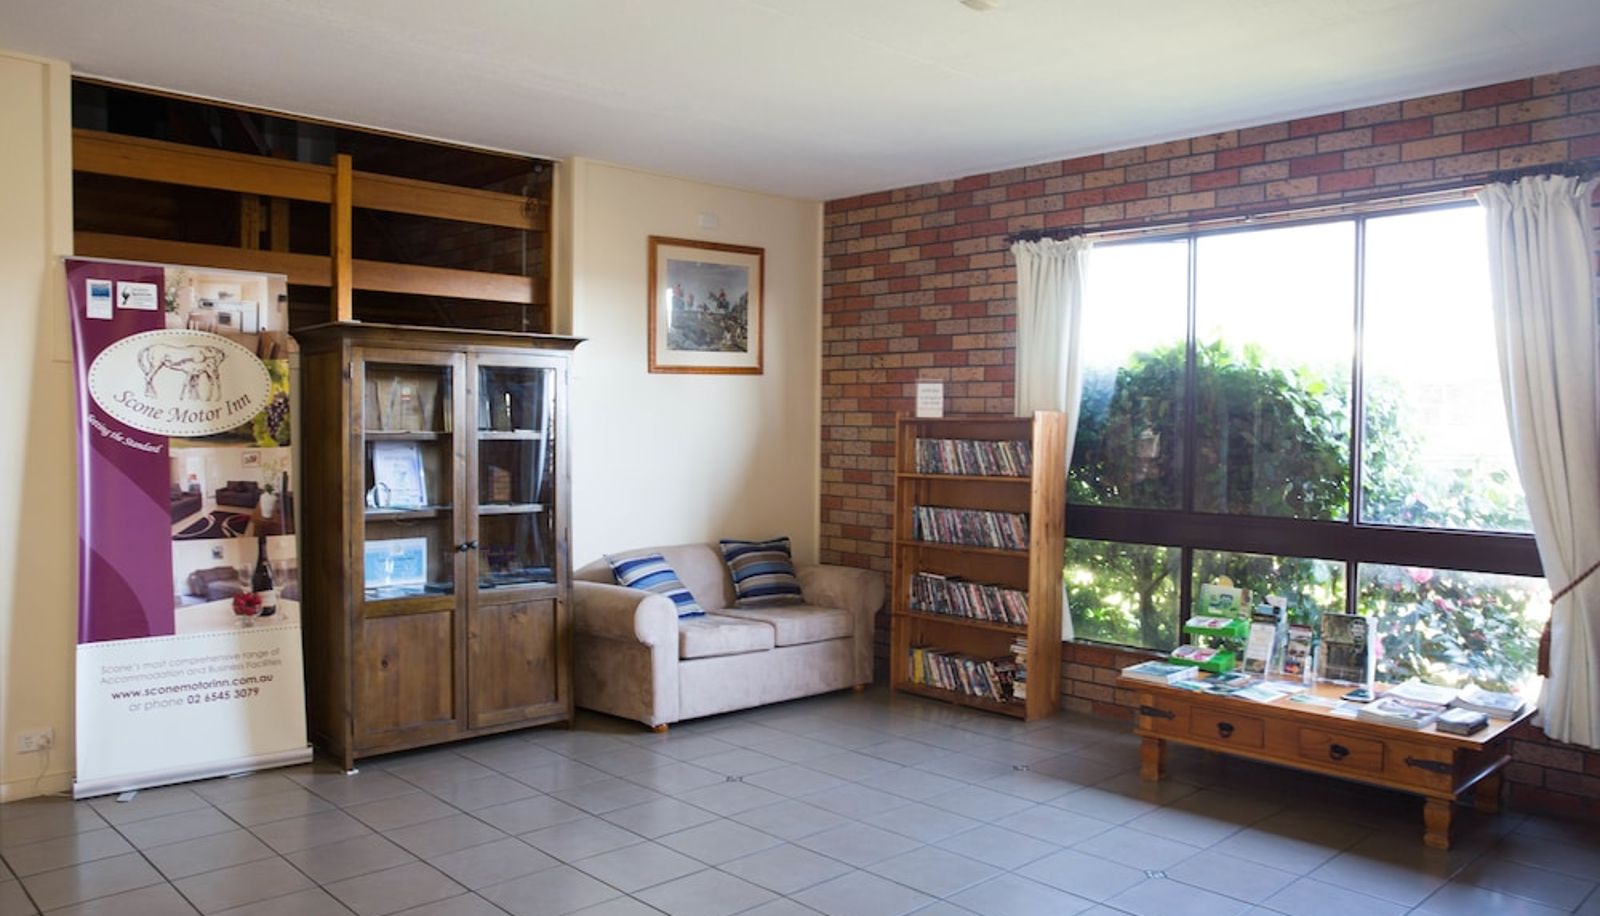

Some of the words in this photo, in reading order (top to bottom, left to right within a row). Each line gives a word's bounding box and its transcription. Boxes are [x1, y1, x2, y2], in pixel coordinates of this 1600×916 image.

[112, 390, 164, 420] Scone
[166, 406, 223, 423] Motor
[225, 394, 251, 415] Inn
[122, 437, 163, 454] Standard
[100, 668, 184, 685] Accommodation
[186, 666, 206, 676] and
[208, 662, 244, 673] Business
[246, 658, 282, 669] Facilities
[143, 659, 167, 670] most
[168, 652, 240, 668] comprehensive
[242, 649, 269, 661] range
[271, 647, 280, 656] of
[112, 674, 273, 700] www.sconemotorinn.com.au
[129, 702, 142, 712] or
[144, 697, 183, 712] phone
[187, 694, 200, 705] 02
[204, 690, 231, 702] 6545
[234, 686, 259, 699] 3079
